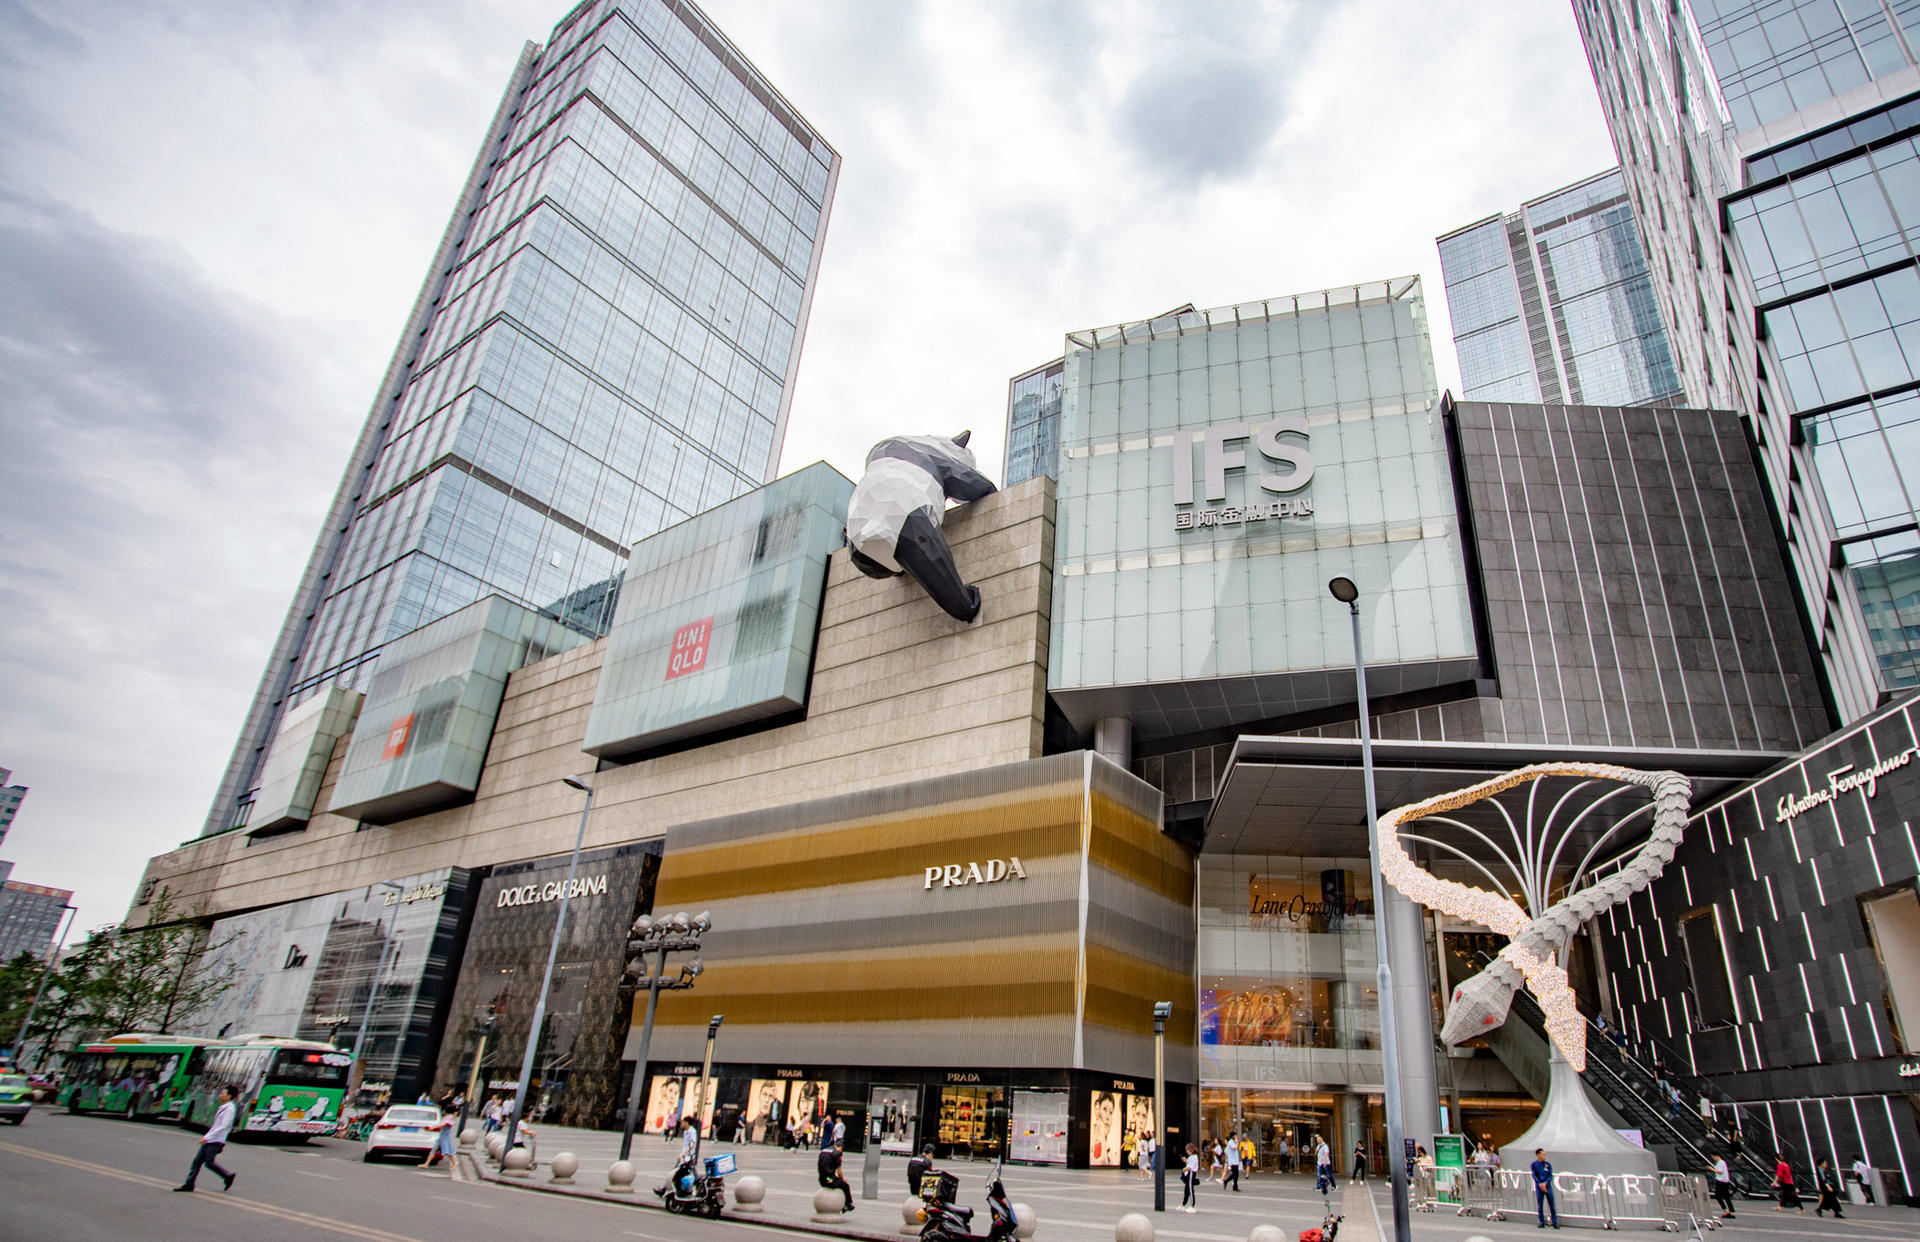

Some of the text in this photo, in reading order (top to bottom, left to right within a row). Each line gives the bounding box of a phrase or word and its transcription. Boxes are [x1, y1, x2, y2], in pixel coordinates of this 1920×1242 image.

[1173, 415, 1316, 506] IFS
[1174, 498, 1314, 531] 国际金融中心
[676, 624, 706, 650] UNI
[671, 646, 704, 674] QLO
[1776, 746, 1919, 822] Salvatore Ferragamo
[924, 856, 1027, 890] PRADA
[1251, 894, 1359, 922] Lane Crawford
[283, 944, 308, 969] Dior
[674, 1066, 697, 1075] PRADA
[777, 1069, 803, 1078] PRADA
[947, 1072, 980, 1083] PRADA
[1255, 1065, 1277, 1081] IFS
[1113, 1080, 1136, 1091] PRADA
